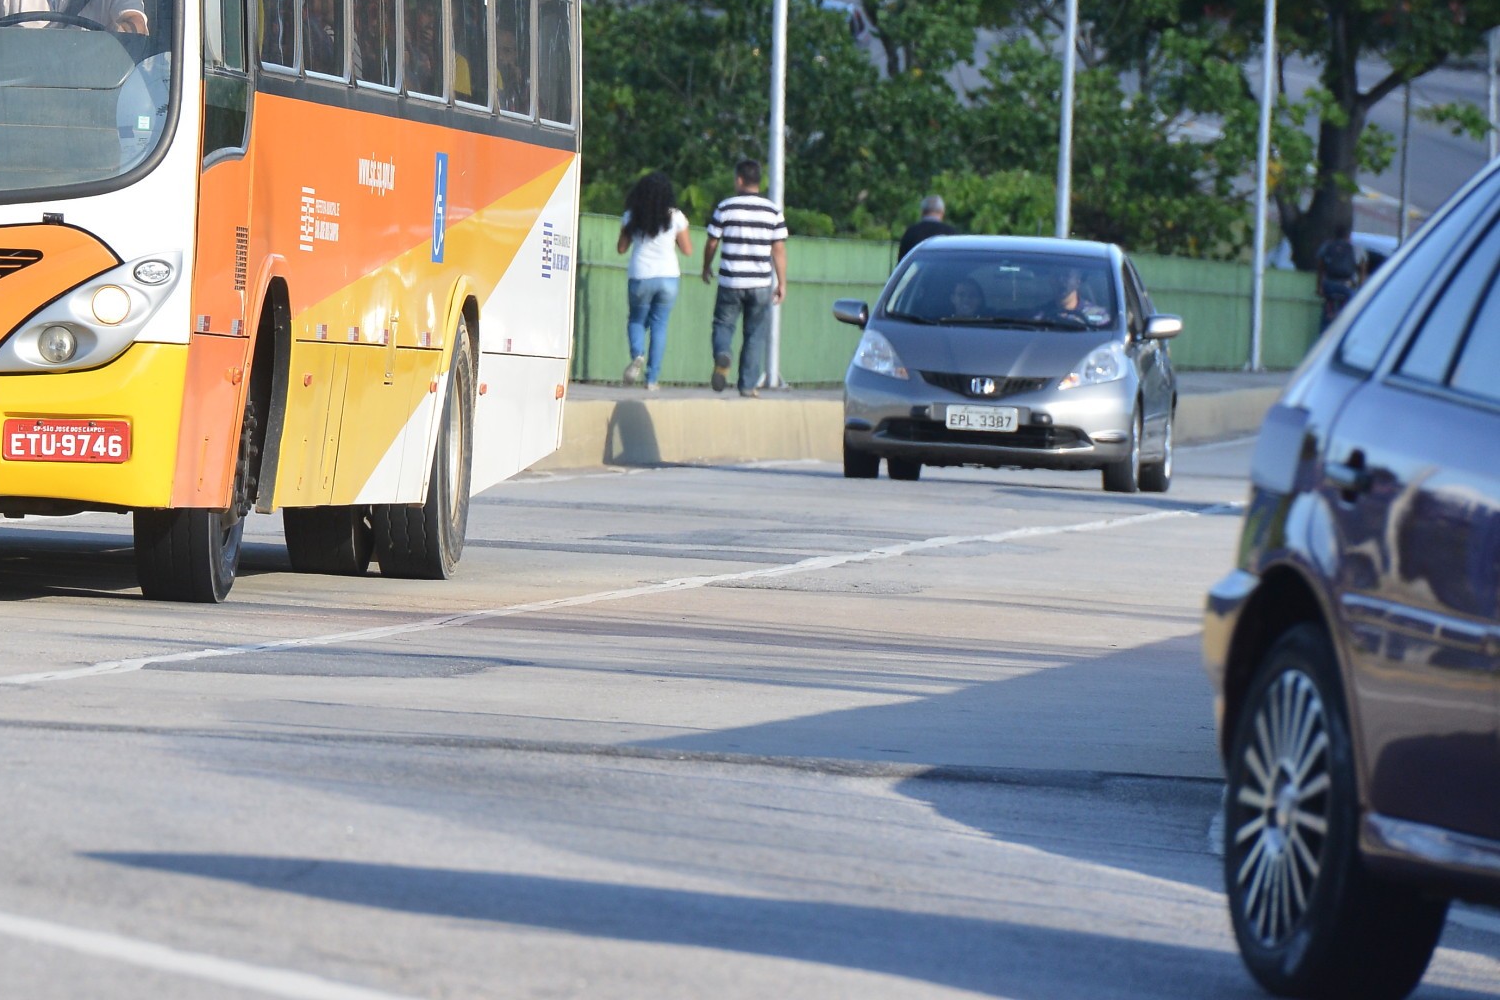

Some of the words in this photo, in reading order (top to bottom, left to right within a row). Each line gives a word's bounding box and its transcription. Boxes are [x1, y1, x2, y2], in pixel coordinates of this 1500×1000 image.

[950, 413, 974, 426] EPL
[980, 415, 1012, 428] 3387
[11, 433, 122, 457] ETU-9746
